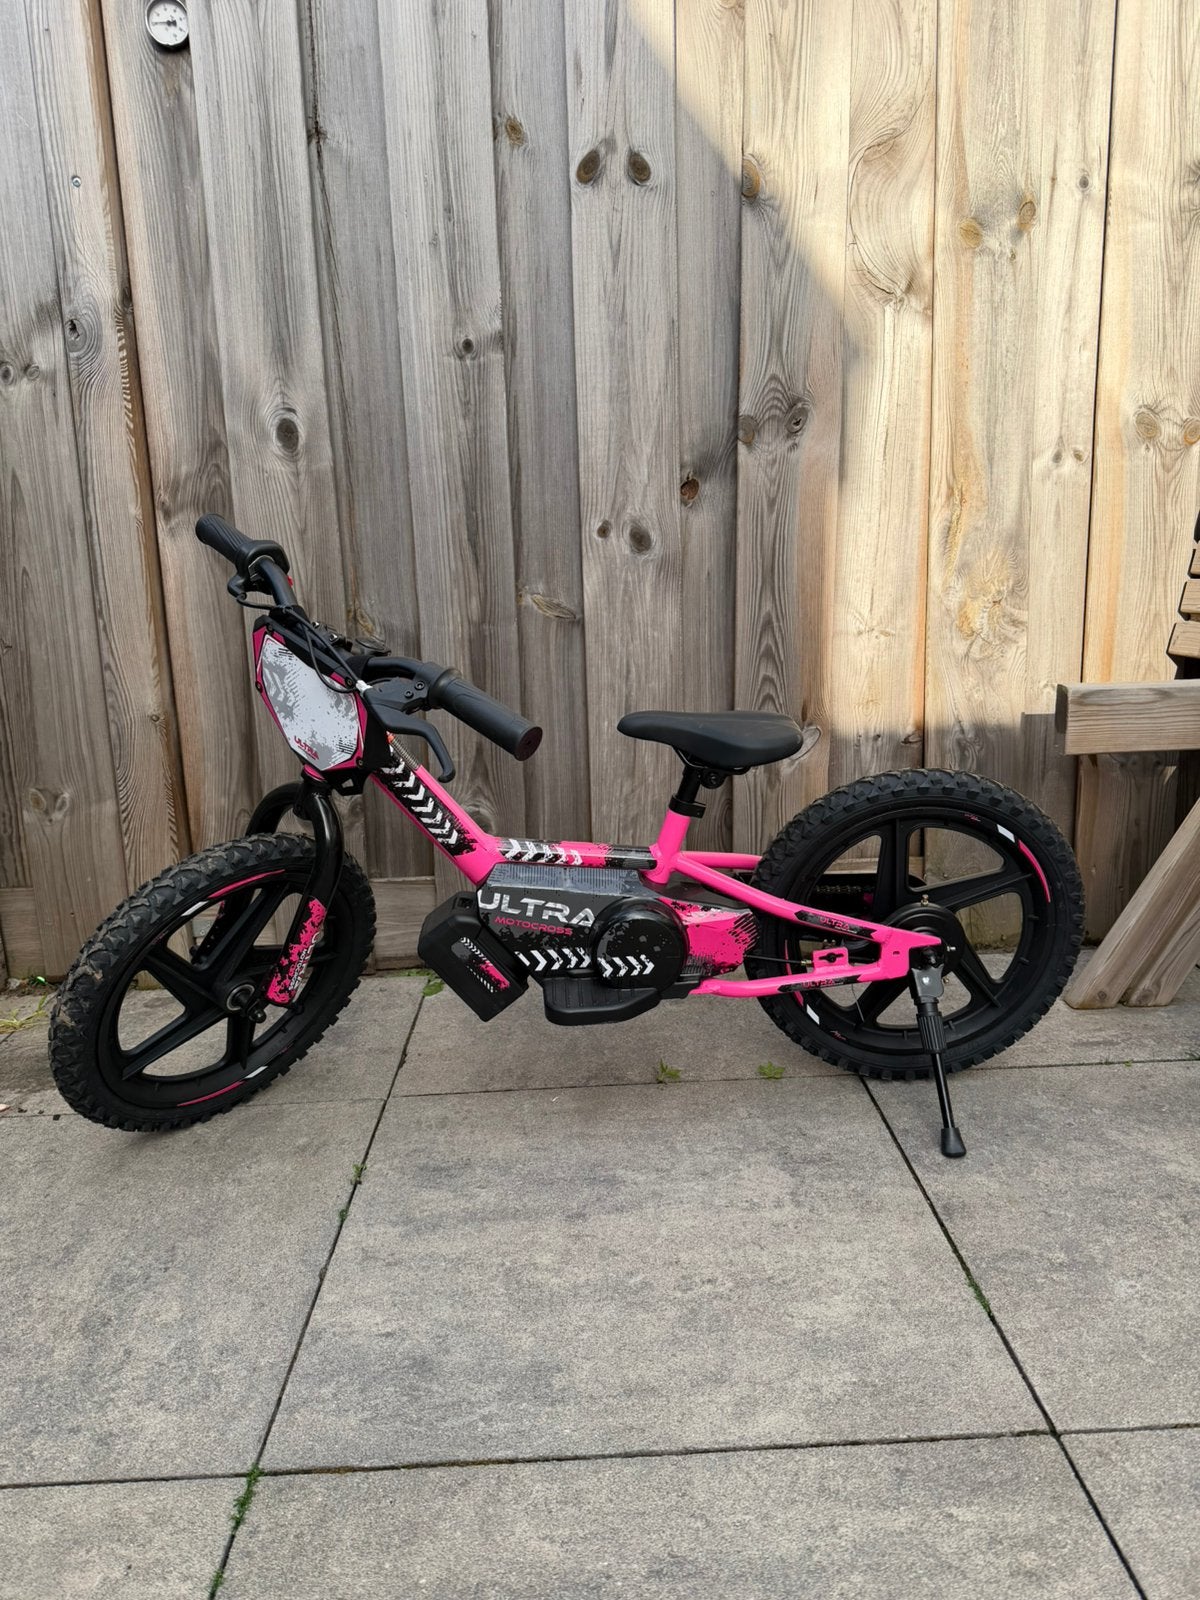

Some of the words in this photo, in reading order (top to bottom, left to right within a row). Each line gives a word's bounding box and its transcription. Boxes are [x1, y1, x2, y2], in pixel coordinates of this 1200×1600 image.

[477, 889, 596, 927] ULTRA
[494, 916, 573, 936] MOTOCROSS
[819, 916, 850, 930] ULTRA
